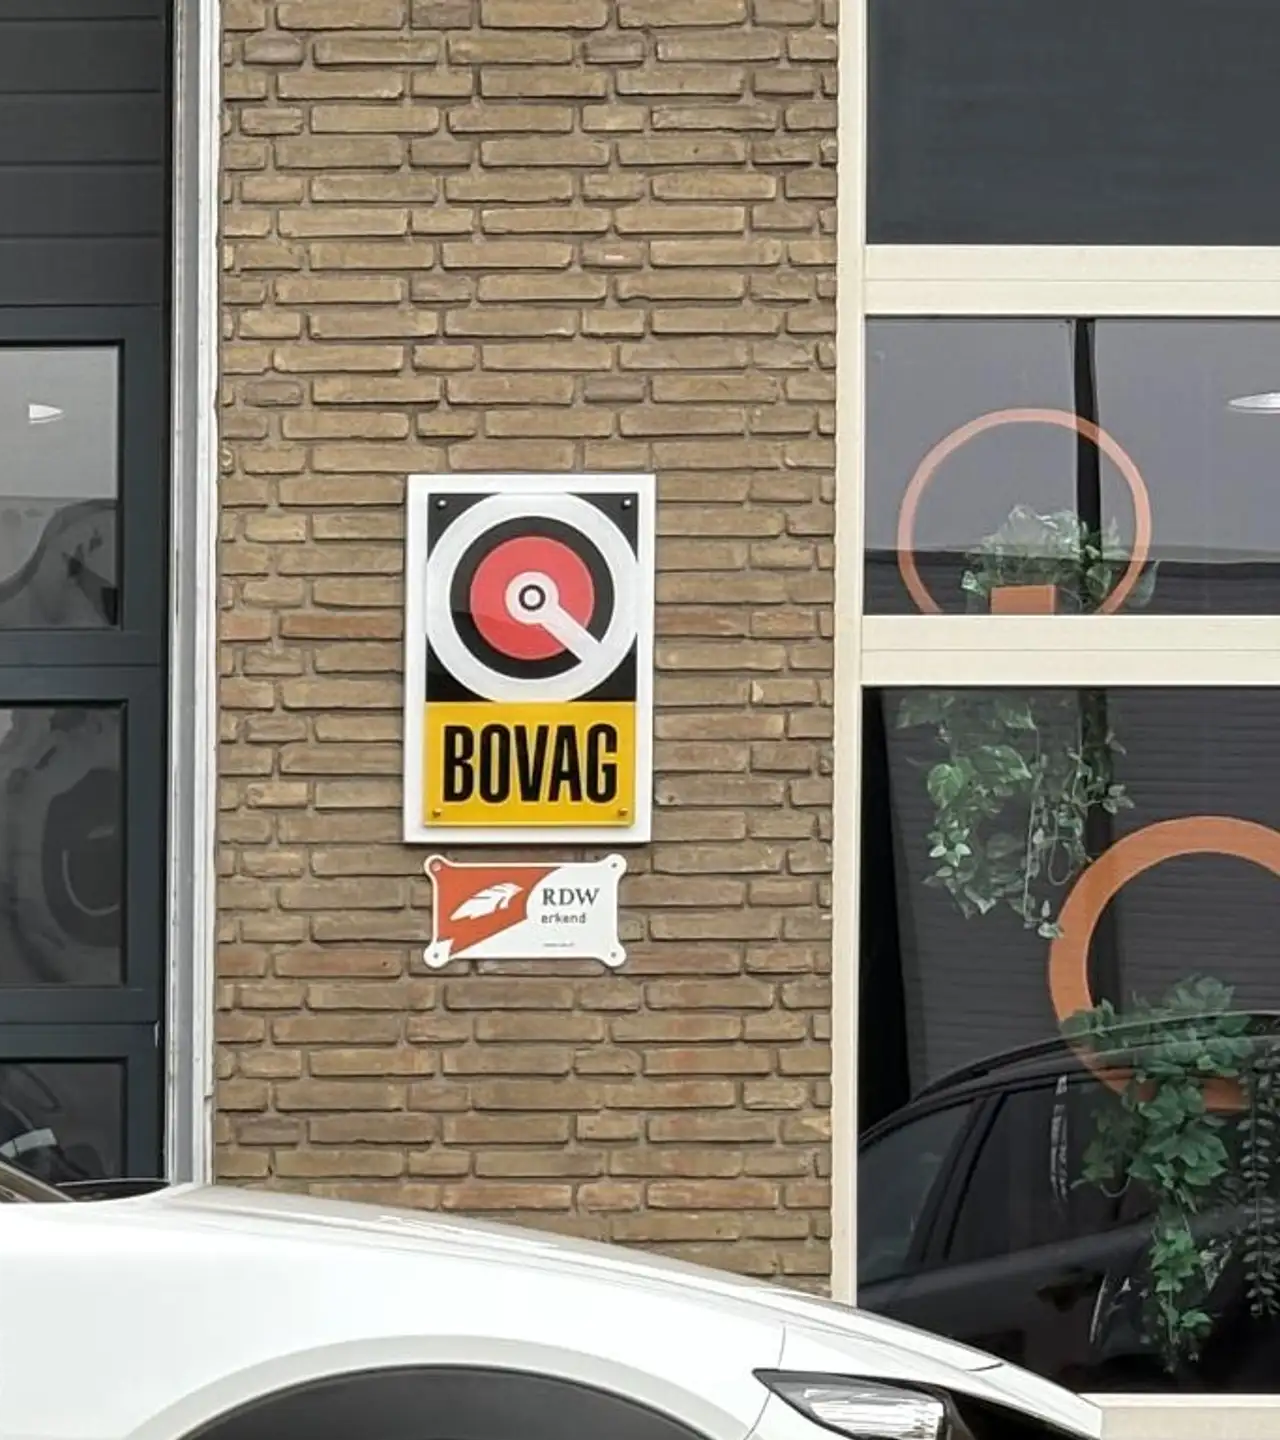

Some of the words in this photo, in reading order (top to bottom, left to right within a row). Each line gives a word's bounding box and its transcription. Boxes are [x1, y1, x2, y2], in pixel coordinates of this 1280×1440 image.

[442, 723, 619, 804] BOVAG
[541, 887, 601, 906] RDW
[541, 911, 587, 924] erkend
